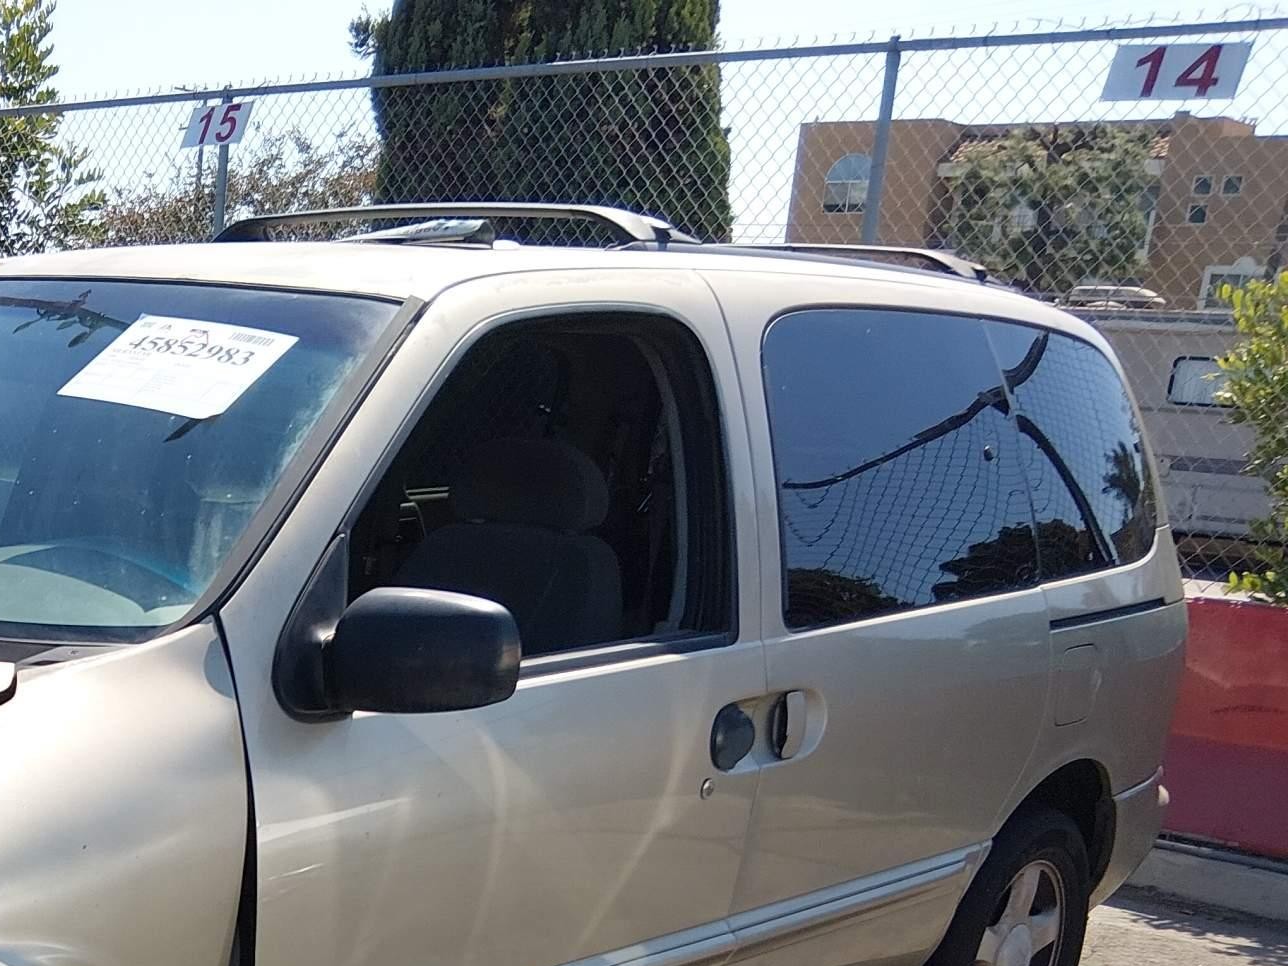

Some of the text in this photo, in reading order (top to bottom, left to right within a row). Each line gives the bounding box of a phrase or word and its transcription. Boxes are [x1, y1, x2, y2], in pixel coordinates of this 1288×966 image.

[1136, 43, 1224, 97] 14
[199, 103, 242, 145] 15
[129, 335, 256, 367] 45852983
